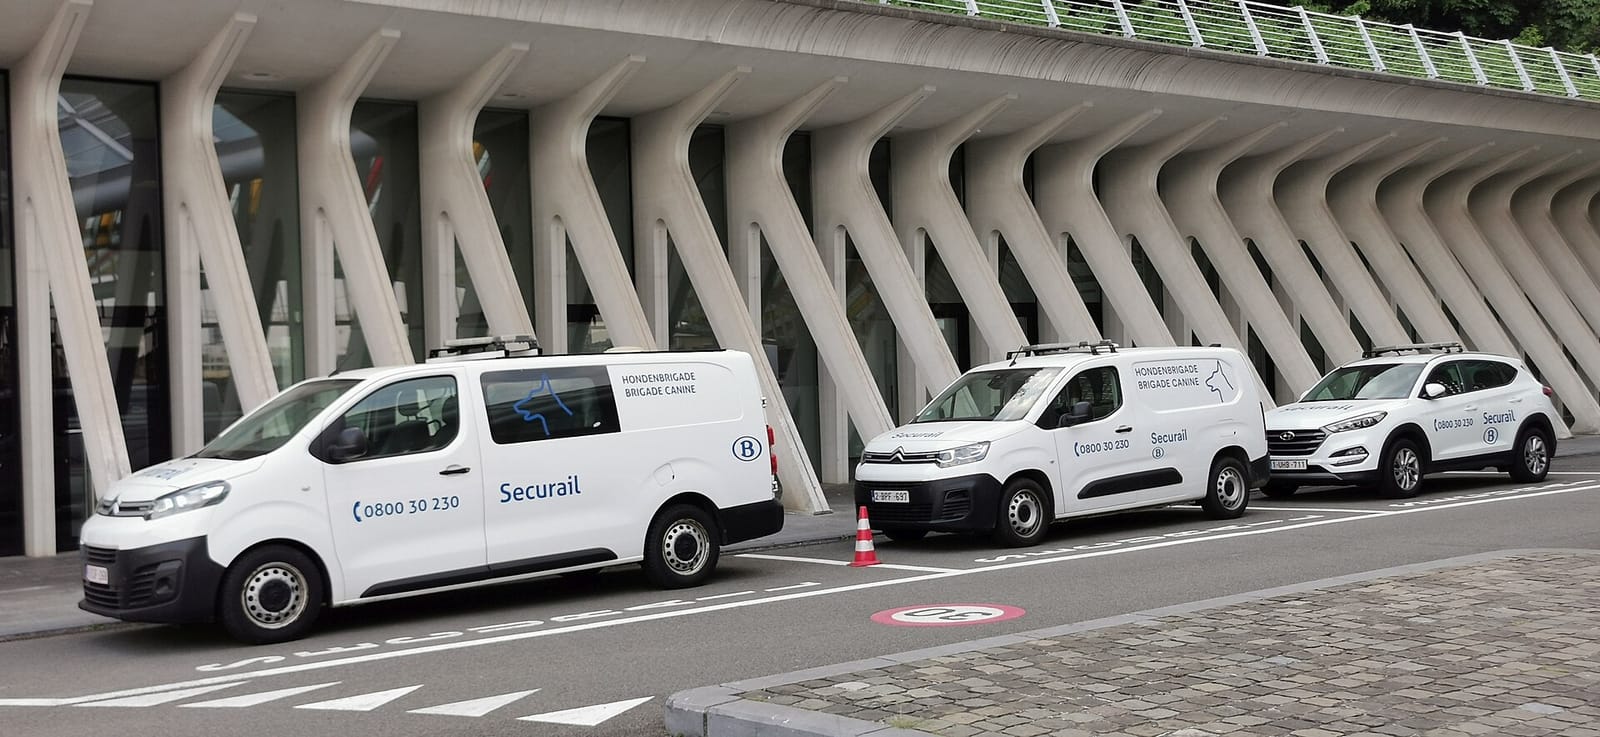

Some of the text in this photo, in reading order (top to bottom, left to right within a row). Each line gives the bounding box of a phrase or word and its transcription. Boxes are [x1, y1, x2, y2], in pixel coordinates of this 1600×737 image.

[622, 371, 696, 384] HONDENBRIGADE
[1135, 364, 1199, 377] HONDENBRIGADE
[625, 384, 695, 397] BRIGADE CANINE
[1138, 377, 1199, 390] BRIGADE CANINE
[1437, 418, 1474, 430] 0800 30 230
[1483, 409, 1515, 424] Securail
[1150, 429, 1188, 445] Securail
[740, 440, 754, 457] B
[1080, 439, 1130, 454] 0800 30 230
[500, 475, 581, 503] Securail
[364, 496, 460, 518] 0800 30 230
